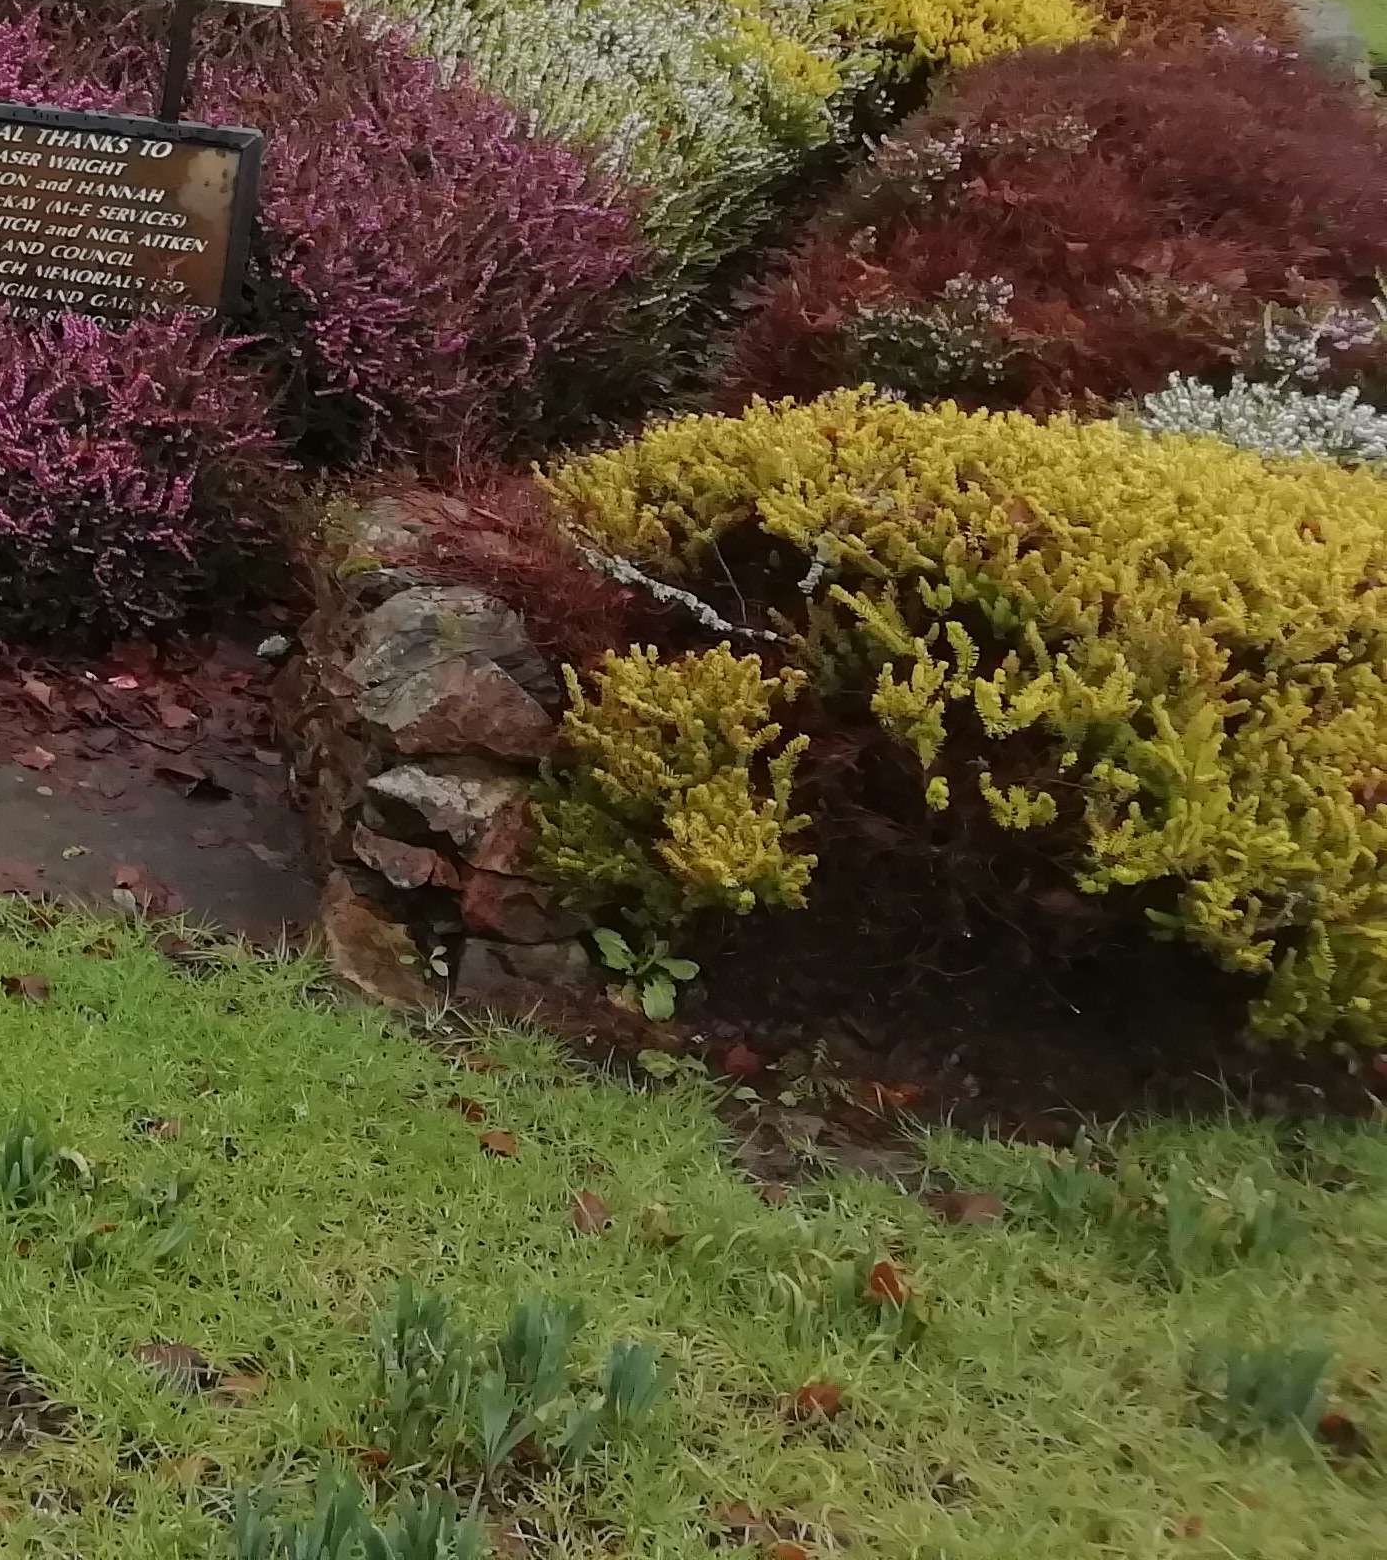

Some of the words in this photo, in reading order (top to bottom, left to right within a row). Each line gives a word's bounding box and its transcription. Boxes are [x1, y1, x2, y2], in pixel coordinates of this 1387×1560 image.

[36, 128, 132, 155] THANKS
[139, 140, 173, 159] TO
[48, 154, 129, 176] WRIGHT
[35, 178, 73, 193] and
[76, 181, 166, 204] HANNAH
[45, 199, 93, 218] (M+E
[96, 205, 188, 229] SERVICES)
[44, 224, 84, 238] and
[86, 226, 134, 245] NICK
[137, 232, 210, 254] AITKEN
[51, 245, 135, 267] COUNCIL
[35, 264, 146, 290] MEMORIALS
